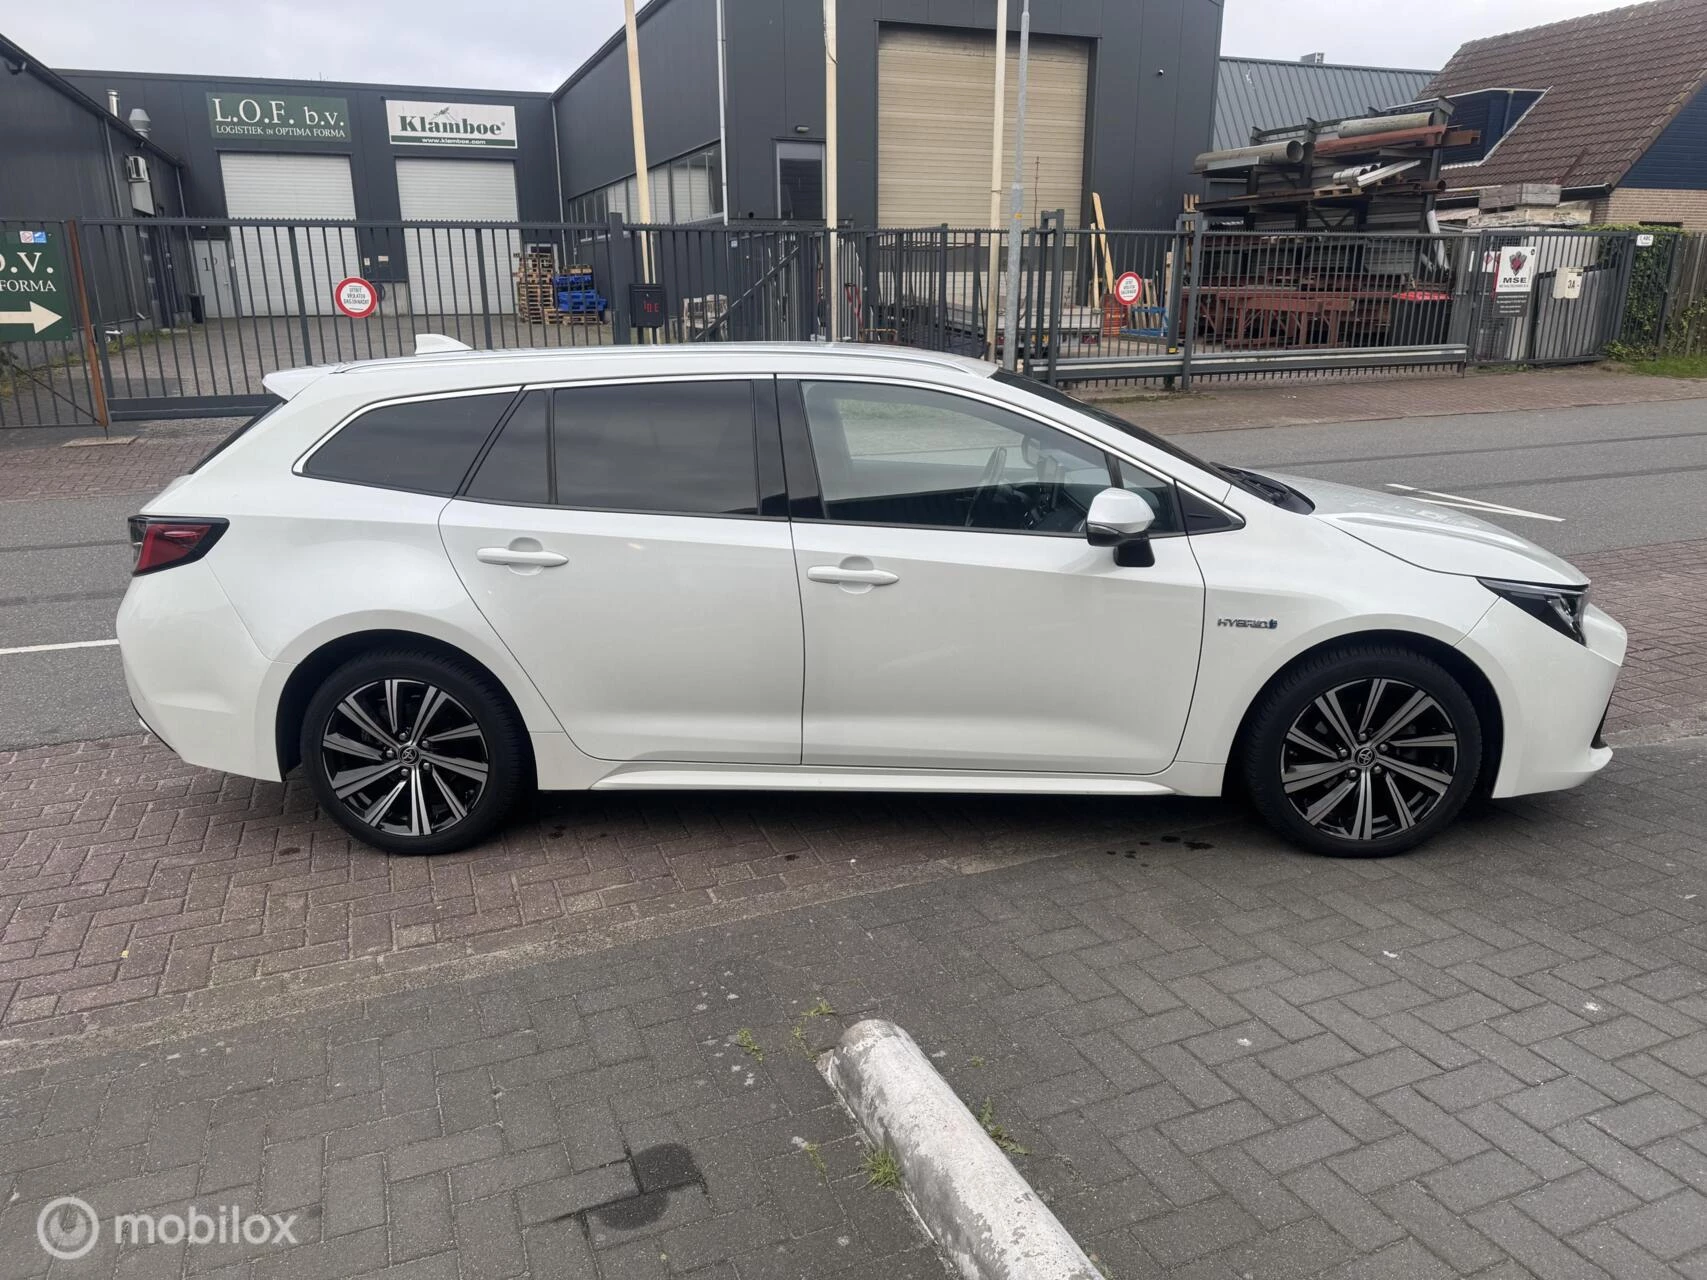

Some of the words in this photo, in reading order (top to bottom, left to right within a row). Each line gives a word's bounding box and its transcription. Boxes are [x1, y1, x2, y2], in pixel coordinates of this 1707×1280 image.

[212, 98, 295, 124] L.O.F.
[303, 106, 345, 126] b.v.
[216, 125, 264, 135] LOGISTIEK
[275, 127, 312, 137] OPTIMA
[313, 128, 346, 138] FORMA
[399, 115, 503, 136] Klamboe
[0, 279, 57, 292] FORMA
[1217, 619, 1268, 629] HYBRID
